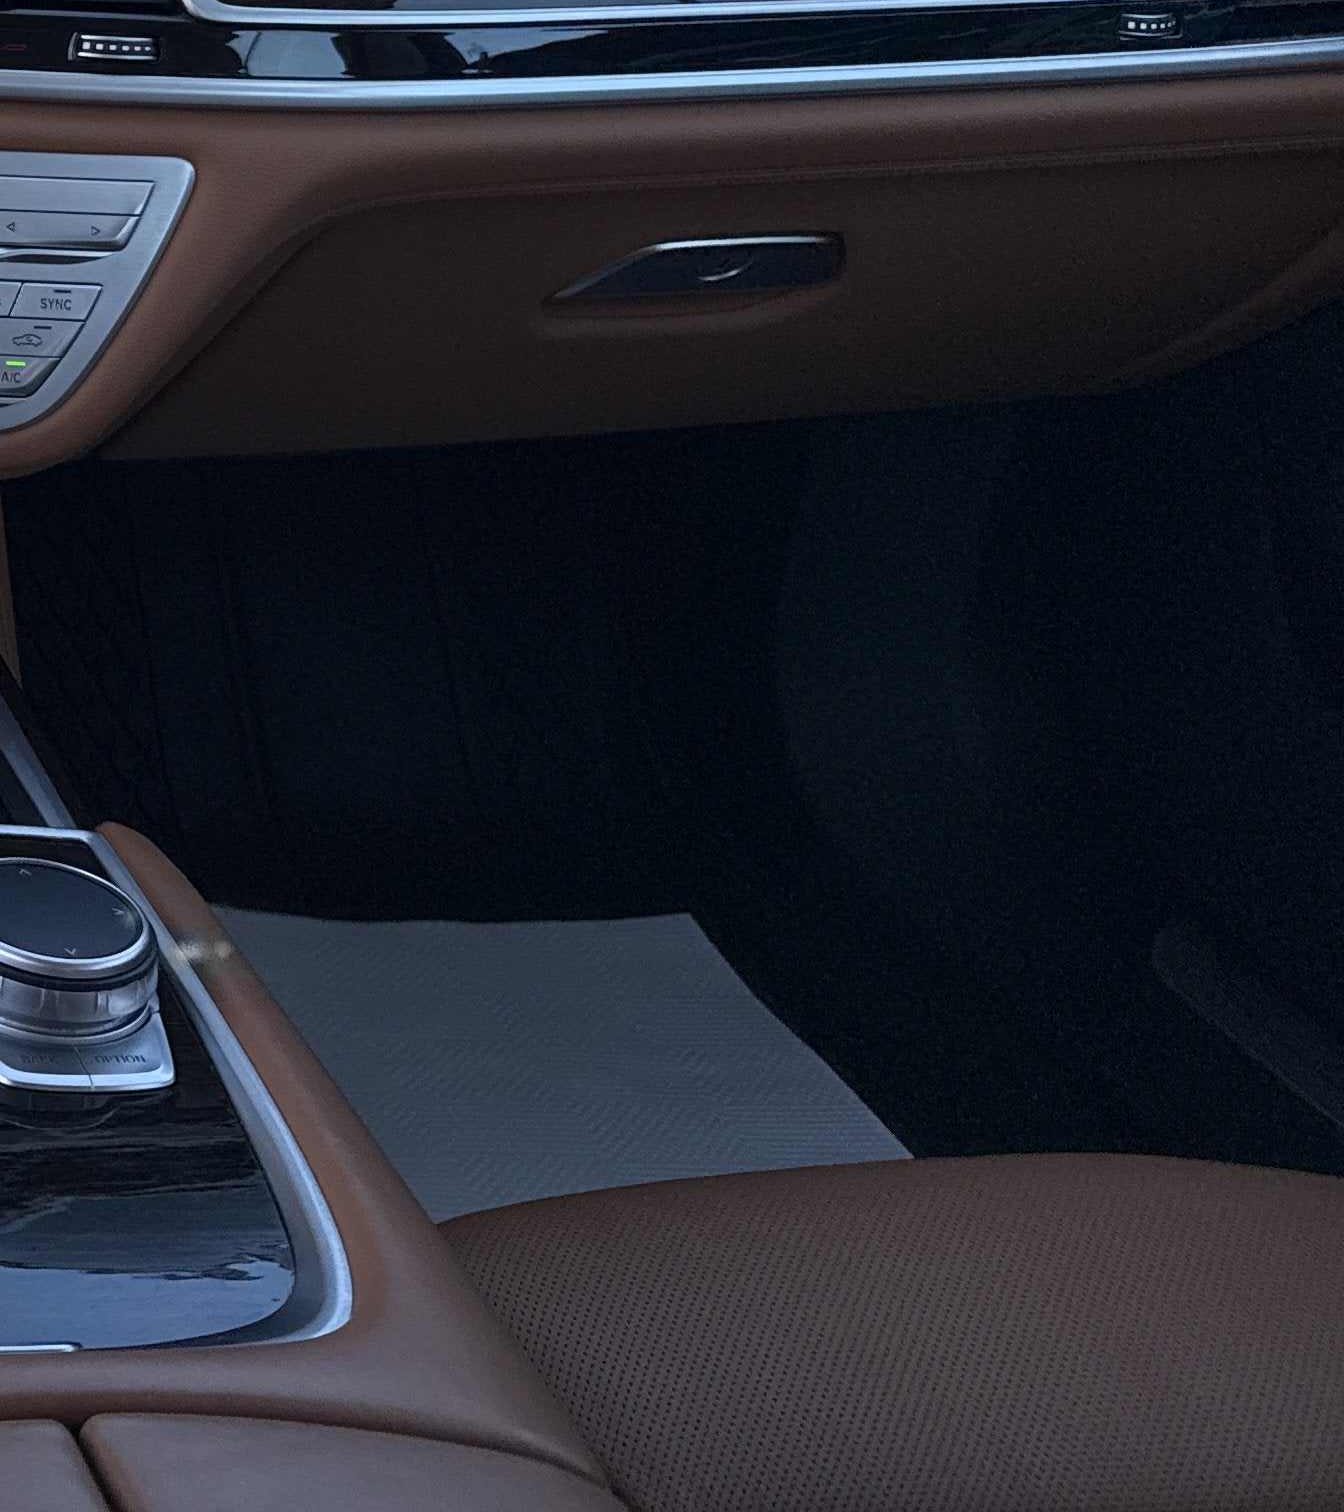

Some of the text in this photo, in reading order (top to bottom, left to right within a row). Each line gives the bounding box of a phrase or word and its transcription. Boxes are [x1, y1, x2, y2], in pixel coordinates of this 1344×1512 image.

[40, 297, 73, 311] SYNC
[1, 371, 21, 384] A/C
[93, 1053, 148, 1065] OPTION
